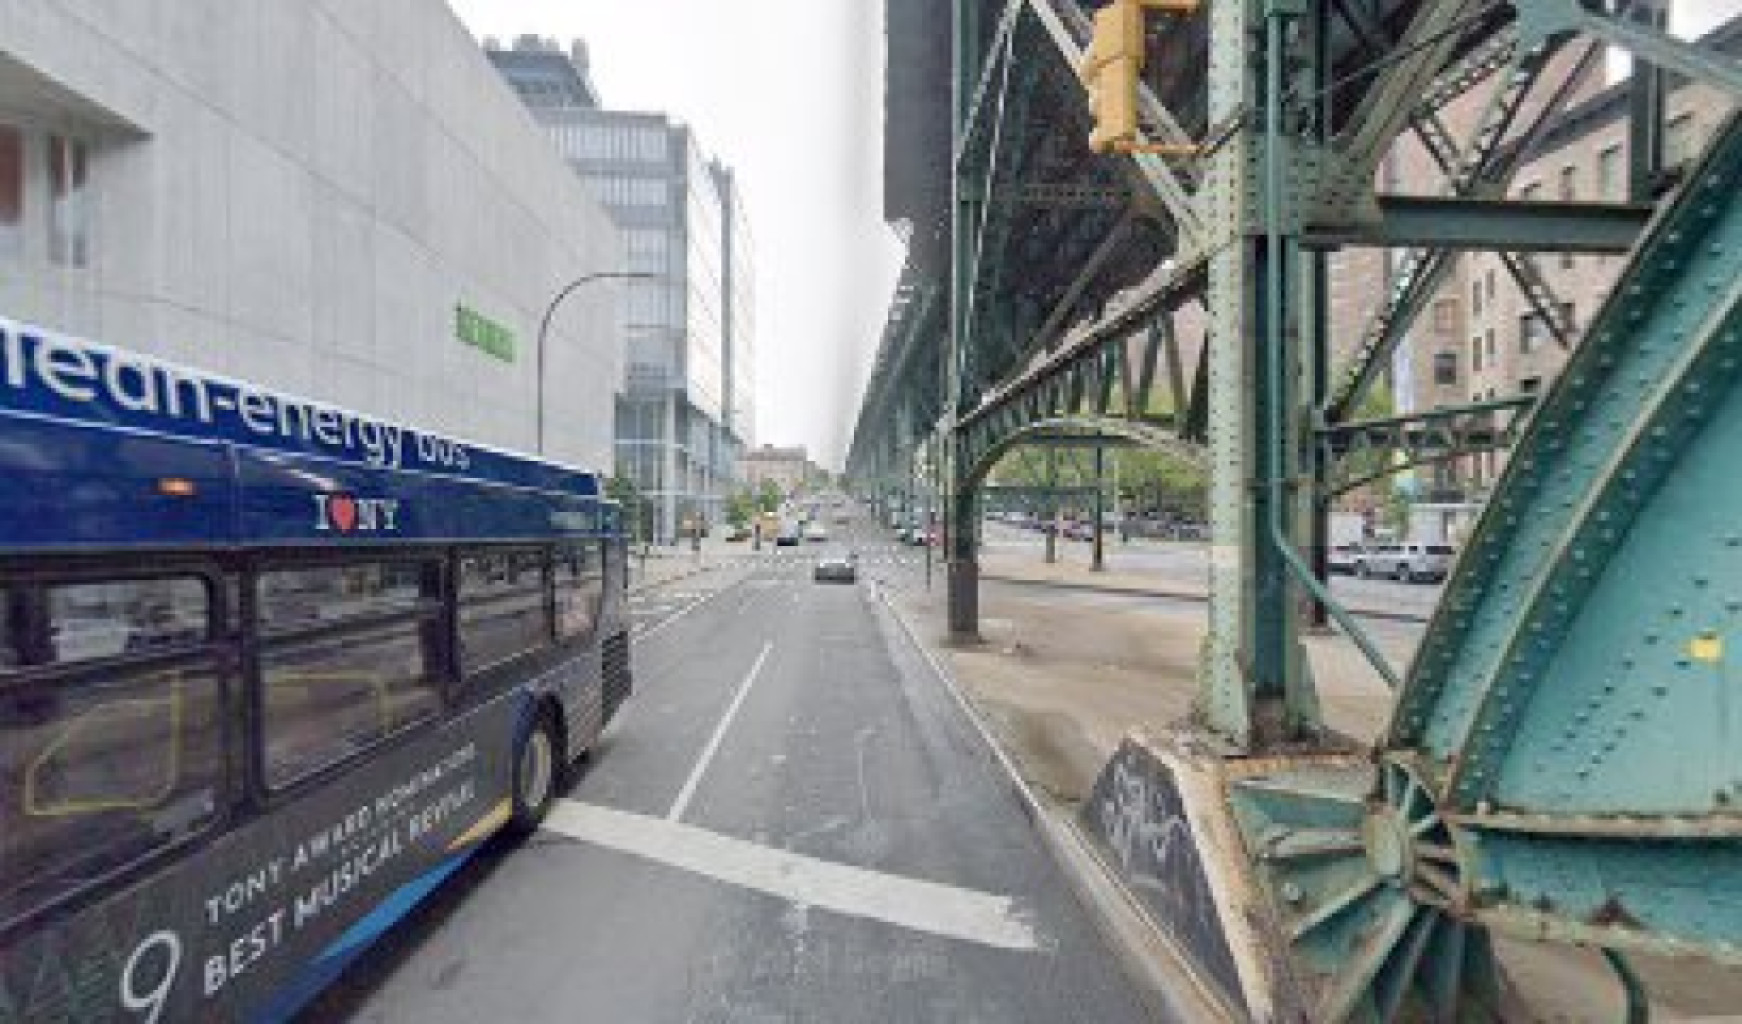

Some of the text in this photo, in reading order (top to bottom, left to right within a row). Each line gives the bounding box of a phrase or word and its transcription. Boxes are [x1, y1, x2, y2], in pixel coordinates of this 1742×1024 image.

[357, 498, 399, 530] NY
[204, 904, 287, 996] BEST
[294, 827, 403, 931] MUSICAL
[205, 855, 290, 924] TONY
[290, 804, 371, 874] AWARD
